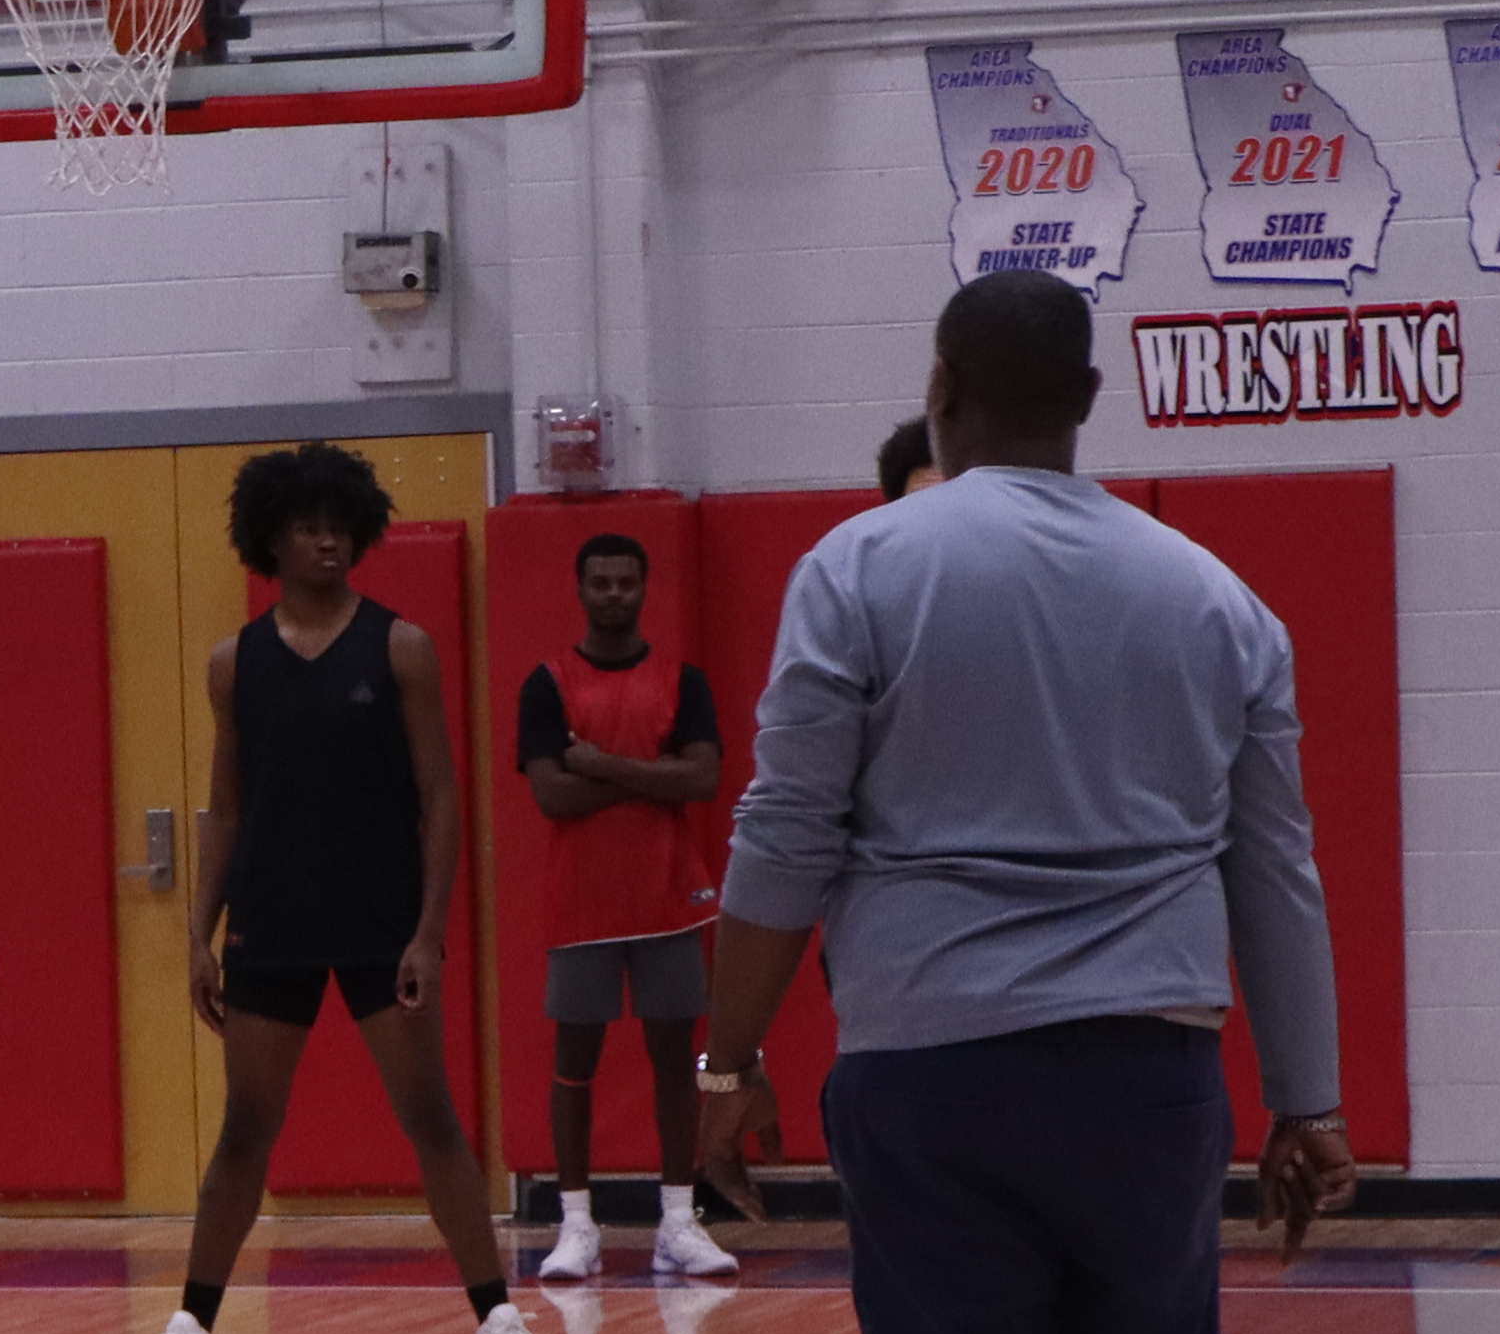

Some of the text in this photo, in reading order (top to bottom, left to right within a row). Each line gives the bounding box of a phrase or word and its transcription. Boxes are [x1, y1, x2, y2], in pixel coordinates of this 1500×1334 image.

[1220, 36, 1263, 55] AREA
[971, 49, 1011, 67] AREA
[1187, 55, 1288, 78] CHAMPIONS
[937, 68, 1036, 90] CHAMPIONS
[990, 123, 1090, 142] TRADITIONALS
[1269, 113, 1313, 132] DUAL
[972, 143, 1097, 197] 2020
[1229, 133, 1347, 186] 2021
[1012, 221, 1075, 246] STATE
[1264, 212, 1328, 236] STATE
[977, 246, 1097, 273] RUNNER-UP
[1225, 236, 1354, 265] CHAMPIONS
[1134, 310, 1461, 417] WRESTLING
